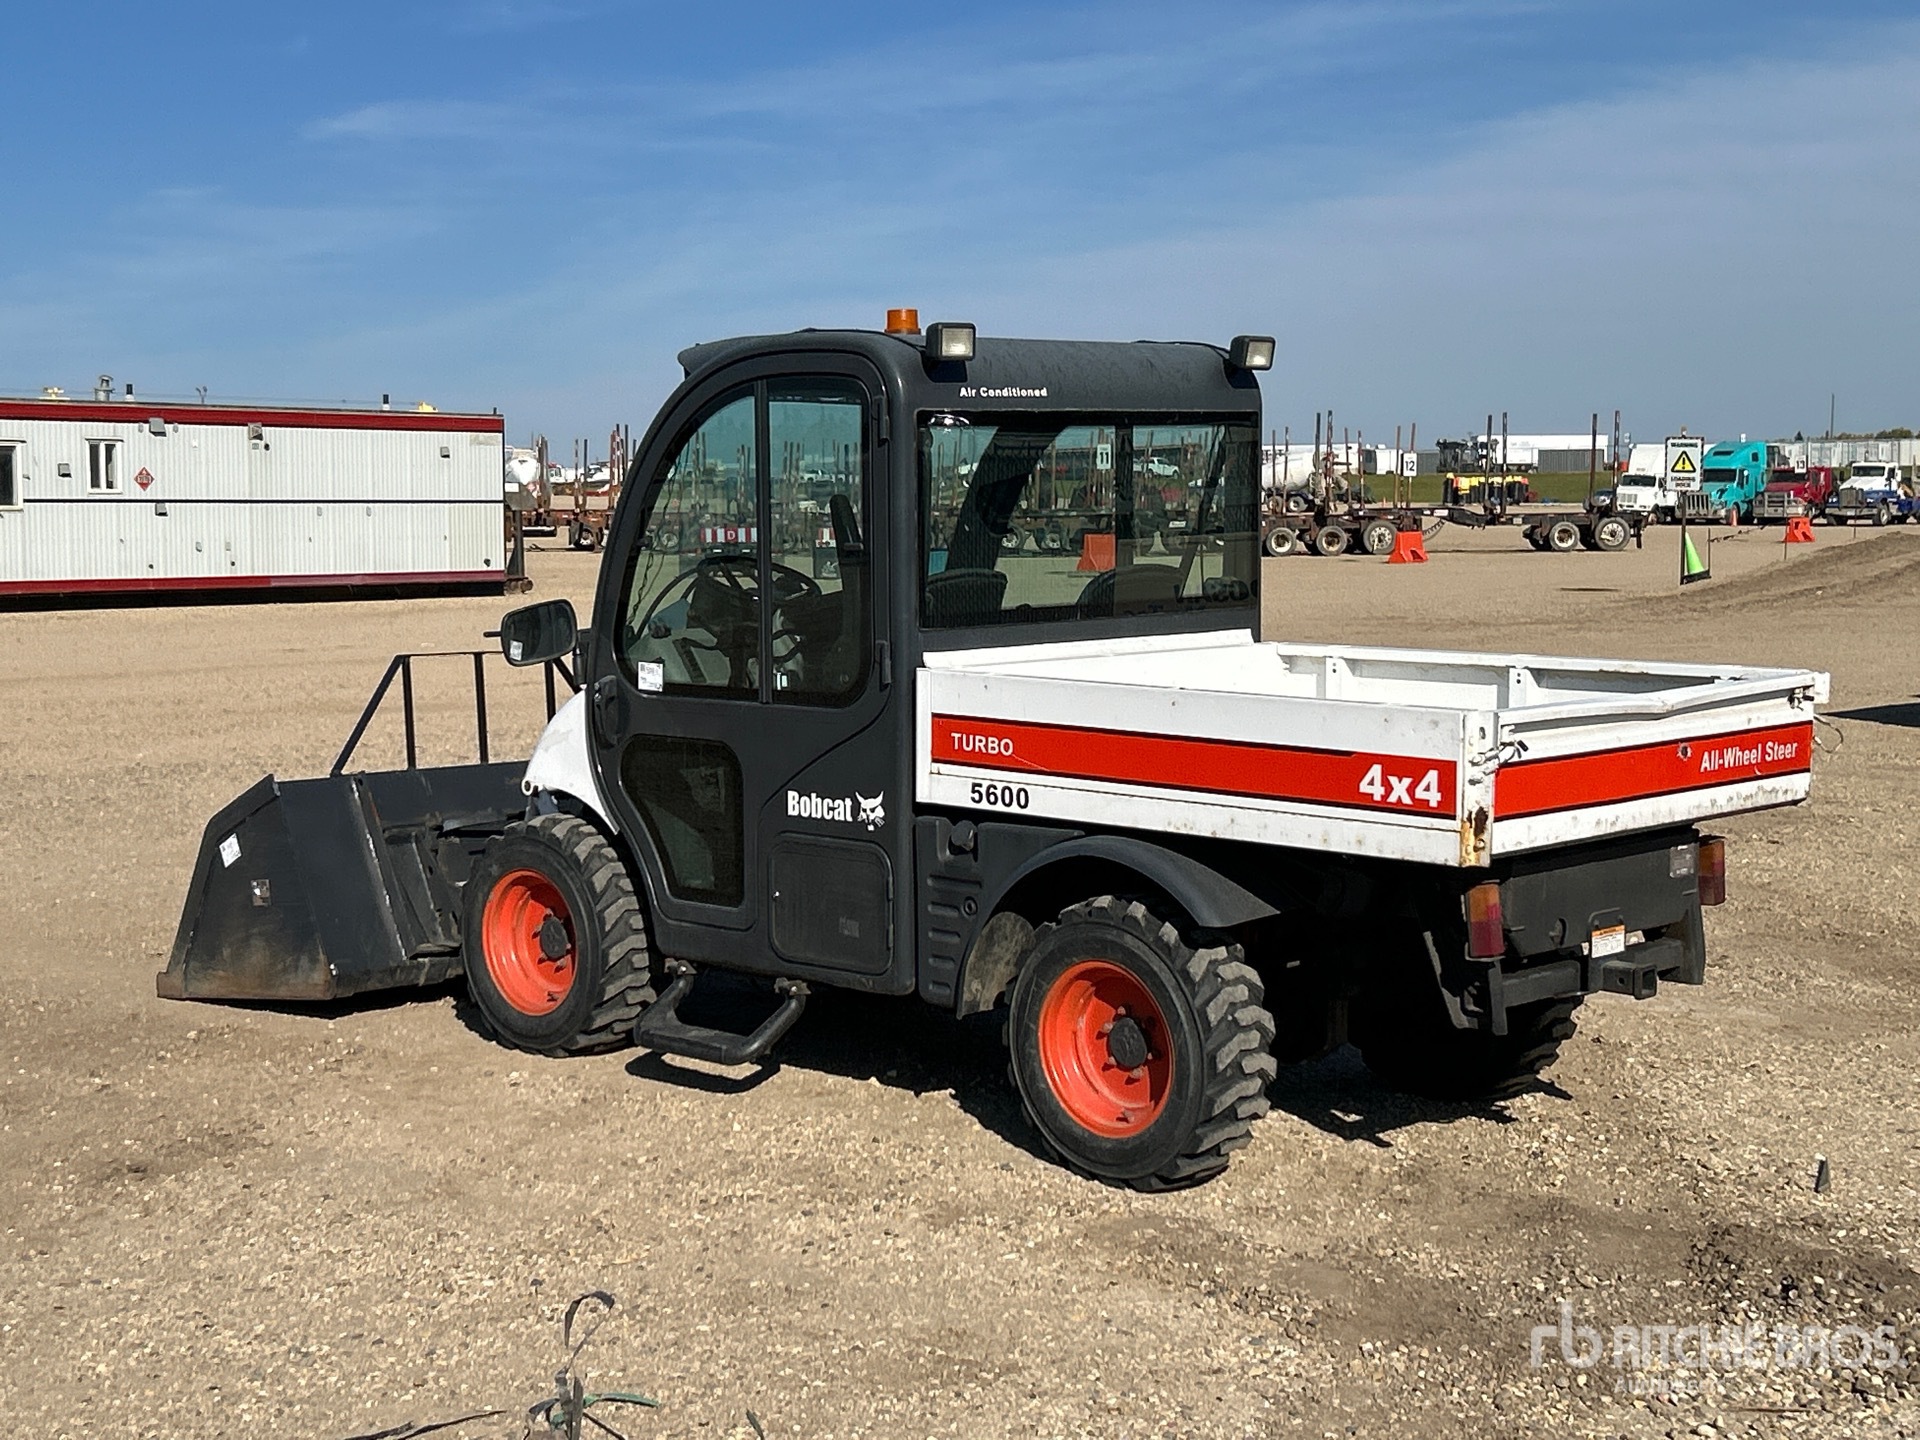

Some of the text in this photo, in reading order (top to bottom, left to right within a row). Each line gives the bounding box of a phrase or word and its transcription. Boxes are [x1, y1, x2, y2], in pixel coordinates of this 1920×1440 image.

[959, 386, 1048, 398] Air Conditioned
[1099, 451, 1109, 465] 11
[1404, 460, 1415, 472] 12
[1796, 460, 1805, 470] 13
[950, 732, 1014, 756] TURBO
[1700, 741, 1798, 773] All-Wheel Steer
[970, 782, 1030, 809] 5600
[1358, 763, 1442, 808] 4x4
[787, 790, 853, 822] Bobcat
